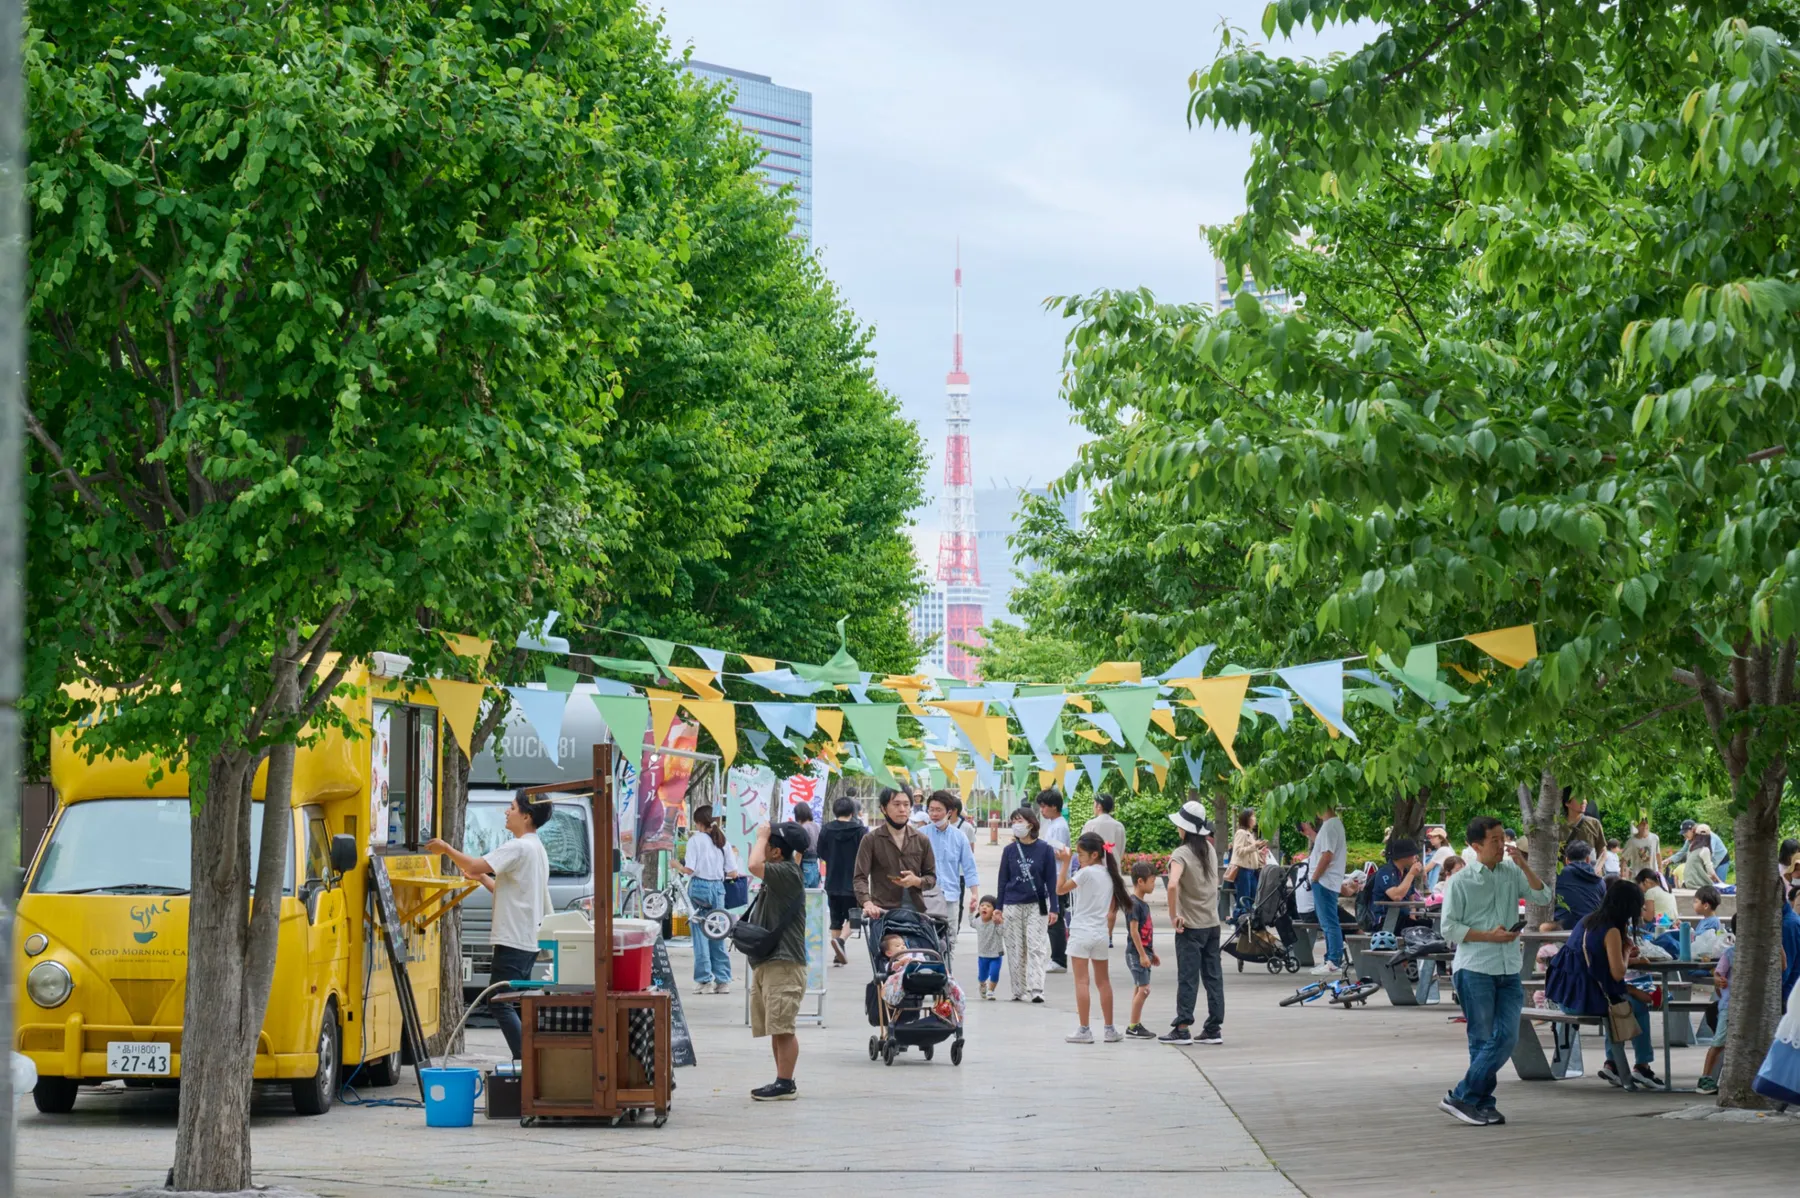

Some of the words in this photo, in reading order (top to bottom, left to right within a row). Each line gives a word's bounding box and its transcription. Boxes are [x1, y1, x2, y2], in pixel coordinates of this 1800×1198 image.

[121, 948, 170, 956] MORNING
[122, 1045, 157, 1054] 品川800
[121, 1055, 167, 1072] 27-43
